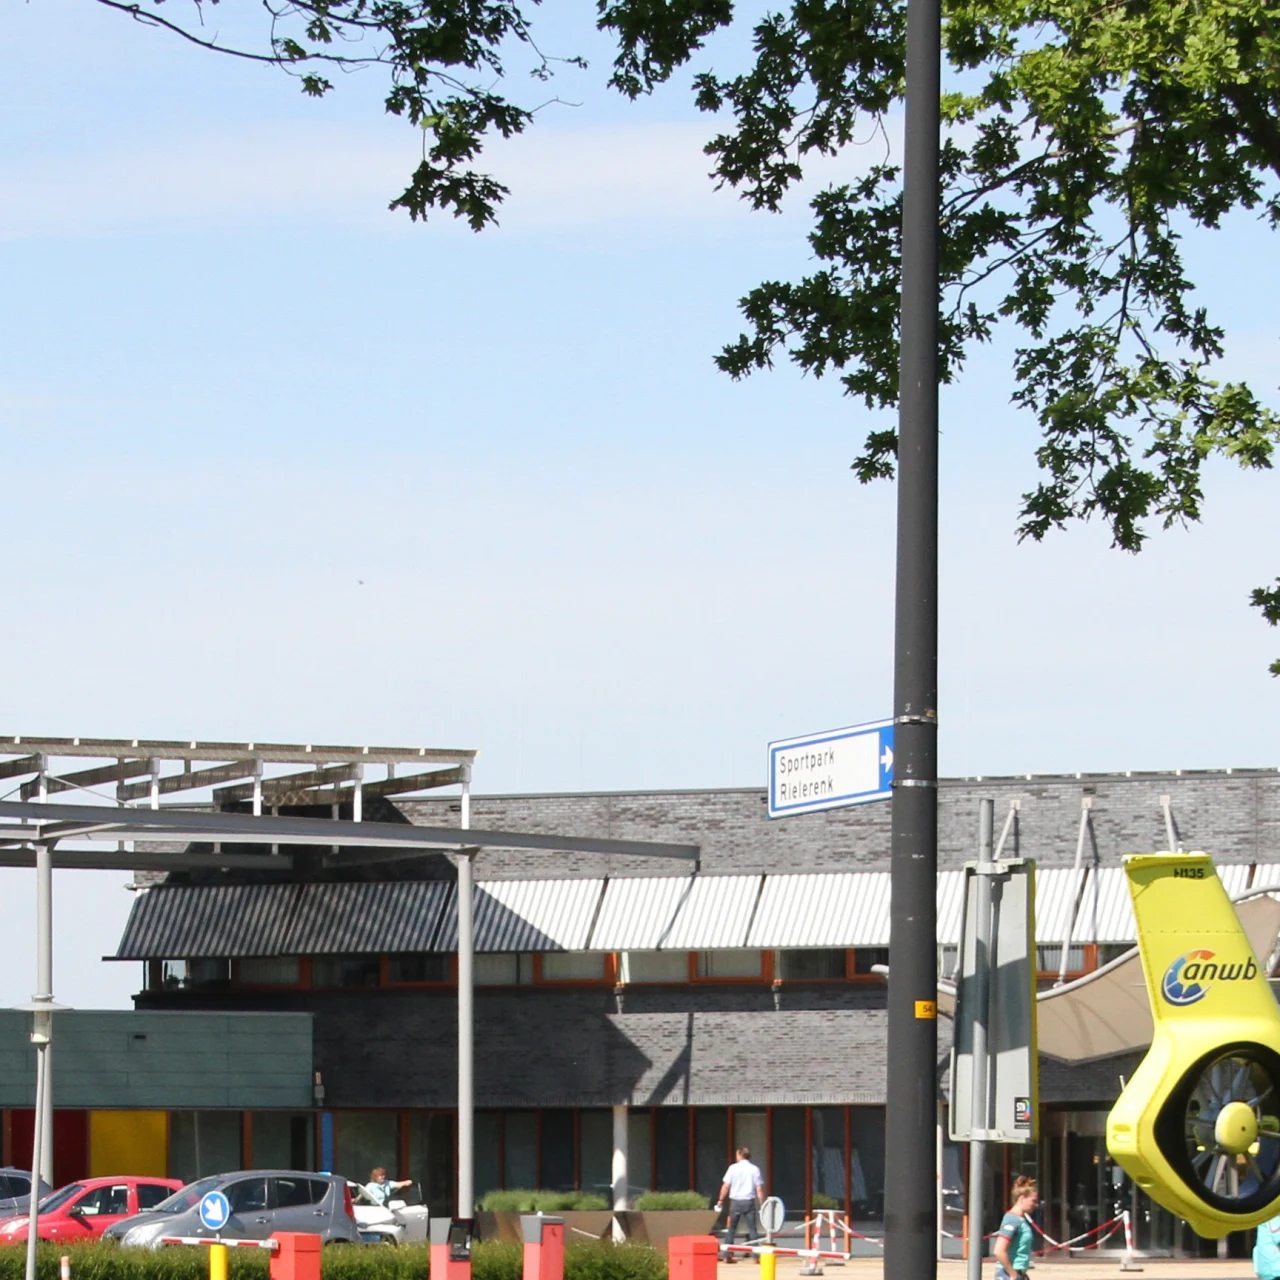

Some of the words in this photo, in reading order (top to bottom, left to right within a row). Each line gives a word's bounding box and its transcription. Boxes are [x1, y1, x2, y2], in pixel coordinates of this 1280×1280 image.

[780, 747, 835, 776] Sportpark
[780, 775, 834, 801] Rielerenk
[1174, 868, 1204, 878] H135
[1183, 957, 1257, 980] anwb
